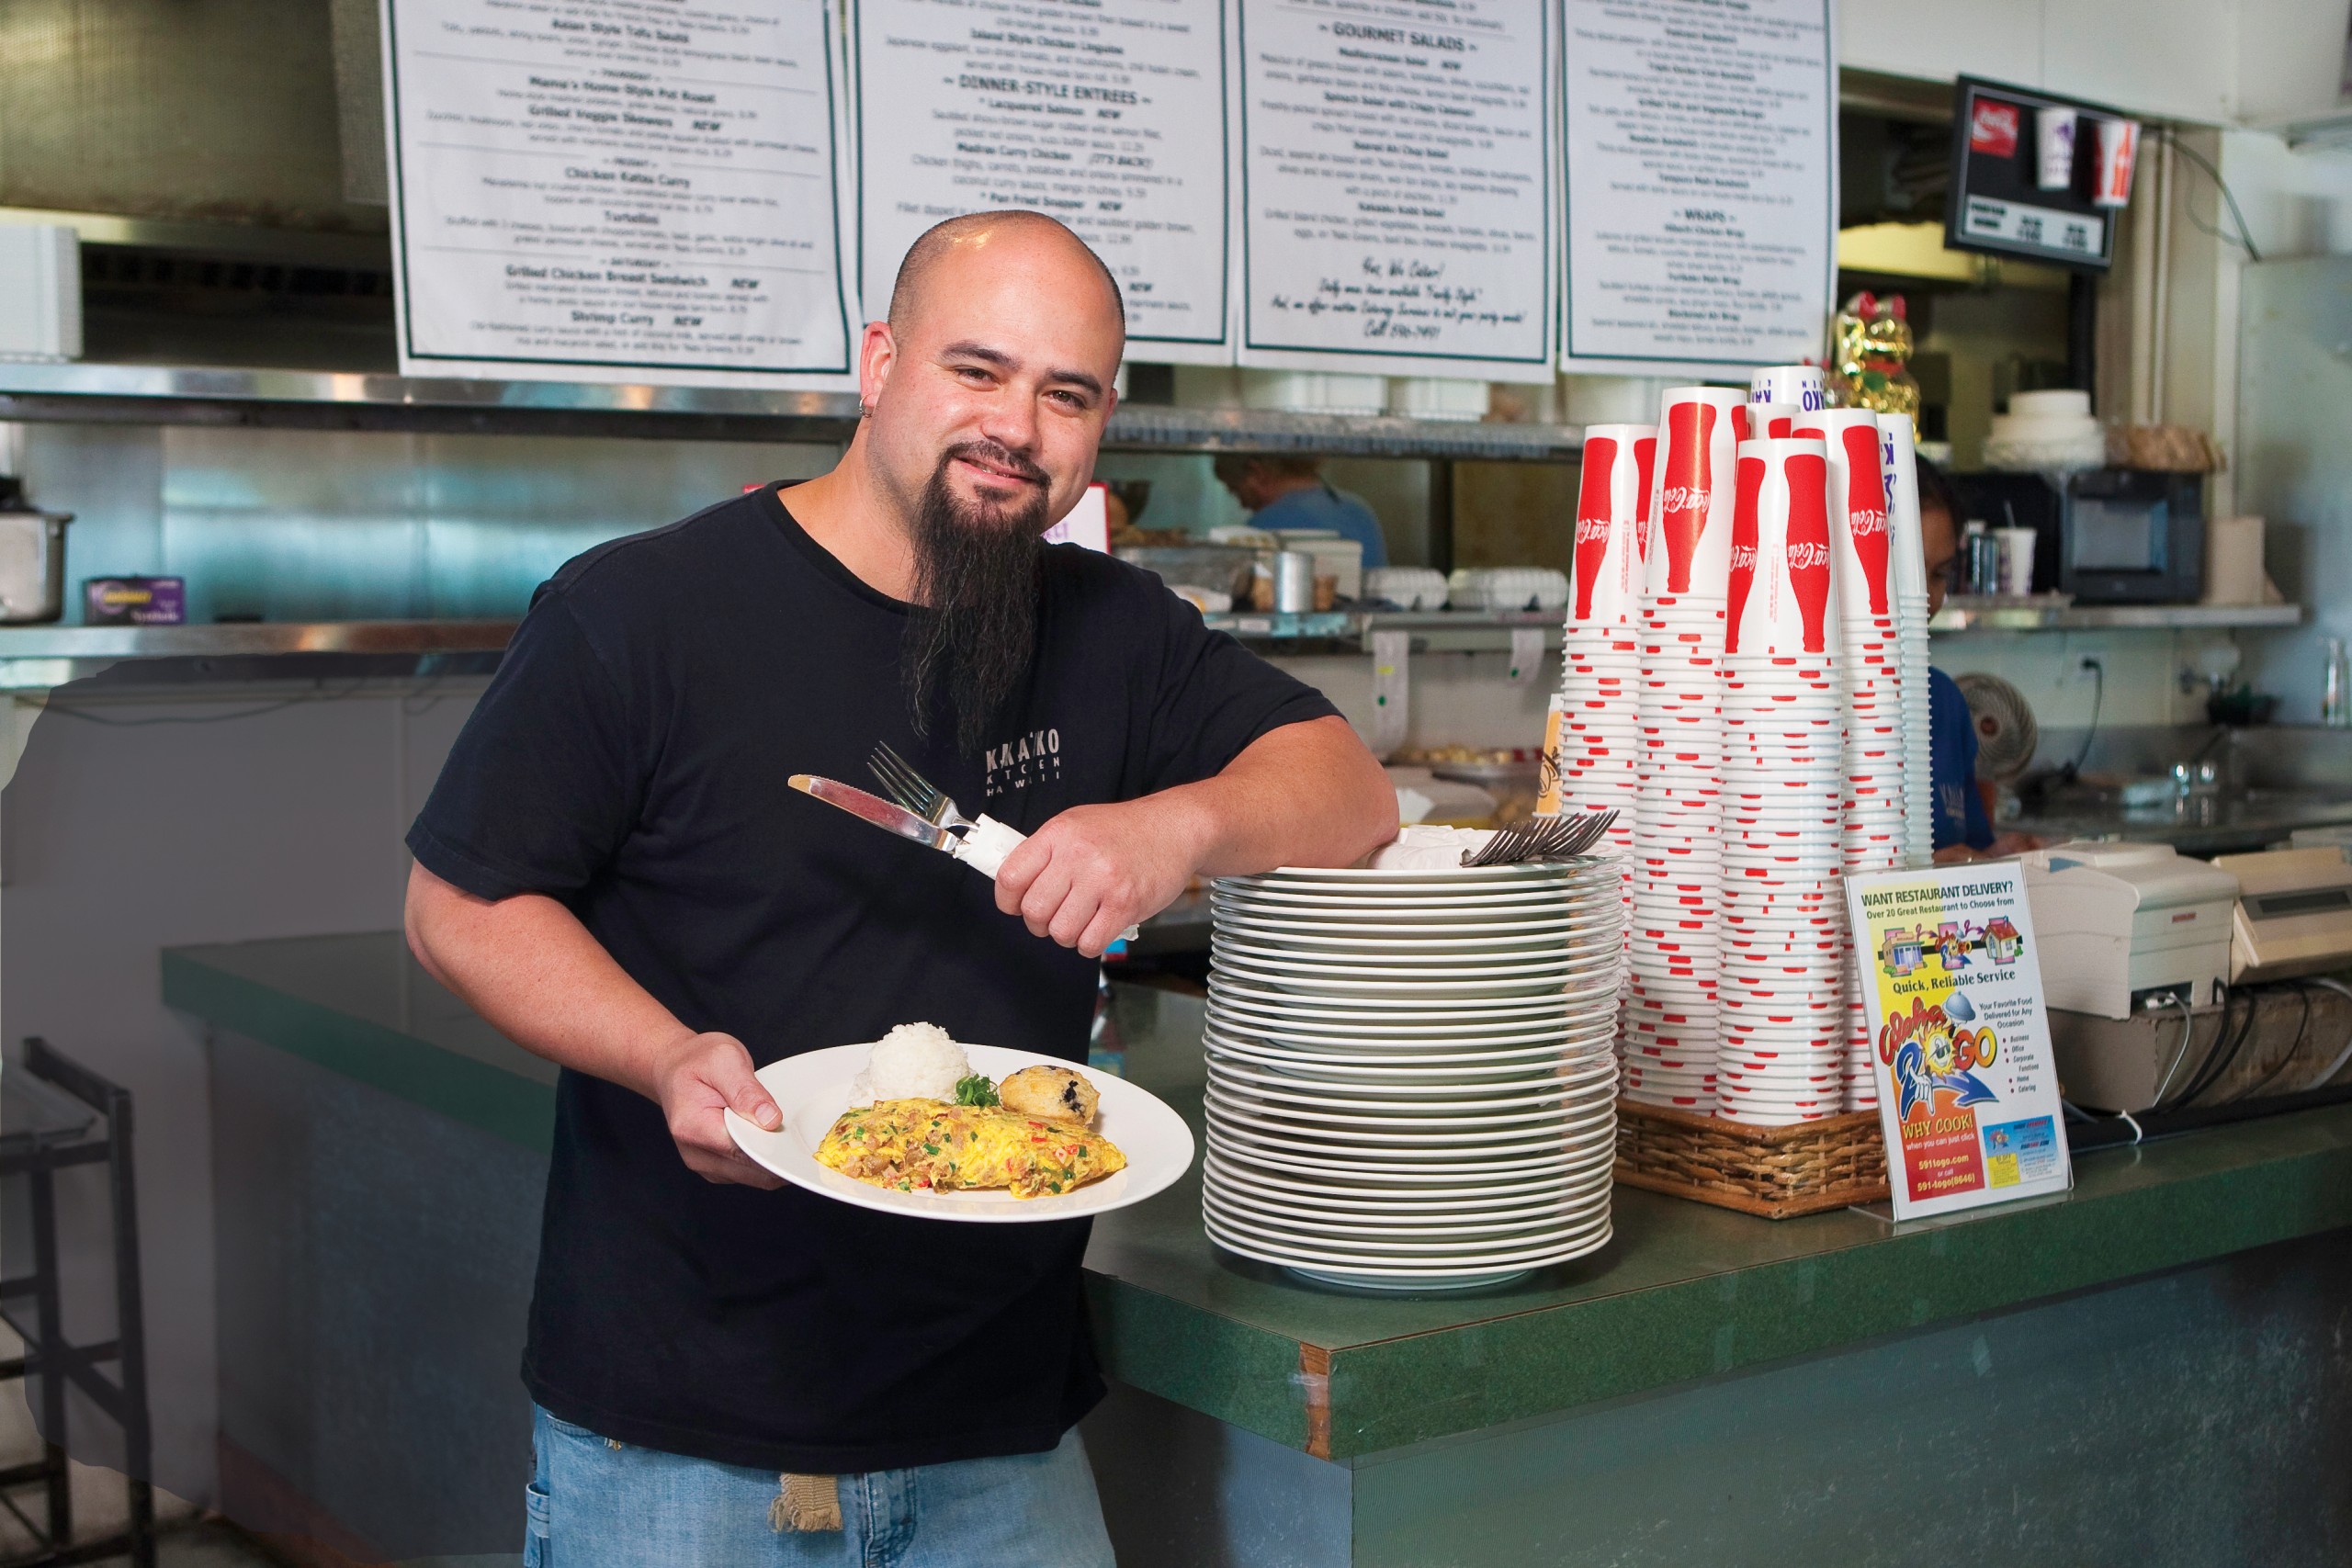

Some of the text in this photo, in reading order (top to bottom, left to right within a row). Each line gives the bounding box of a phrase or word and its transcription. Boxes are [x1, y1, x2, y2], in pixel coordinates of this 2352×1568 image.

[1037, 36, 1076, 51] Chicken
[1332, 21, 1464, 51] GOURMET SALADS
[958, 73, 1137, 107] DINNER-STYLE ENTREES
[1097, 109, 1121, 121] NEW
[1031, 146, 1071, 162] Chicken
[564, 167, 616, 183] Chicken
[659, 174, 690, 188] Curry
[1099, 200, 1123, 212] NEW
[1684, 208, 1725, 222] WRAPS
[506, 263, 759, 289] Grilled Chicken Breast Sandwich NEW
[572, 309, 703, 328] Shrimp Curry NEW
[1664, 486, 1711, 513] Coca-Cola
[1850, 509, 1888, 536] oca-Cola
[1788, 542, 1829, 570] oca-Cola
[1861, 881, 2013, 907] WANT RESTAURANT DELIVERY?
[1866, 897, 2014, 919] Over 20 Great Restaurant to Choose from
[1893, 969, 2015, 995] Quick, Reliable Service
[1984, 1008, 2032, 1021] Delivered for Any
[1994, 999, 2017, 1009] Favorite
[1879, 996, 1947, 1066] Aloha
[1997, 1020, 2024, 1029] Occasion
[1953, 1025, 1998, 1071] GO
[1902, 1112, 1973, 1140] WHY COOK!
[1905, 1132, 1975, 1151] when you can just click
